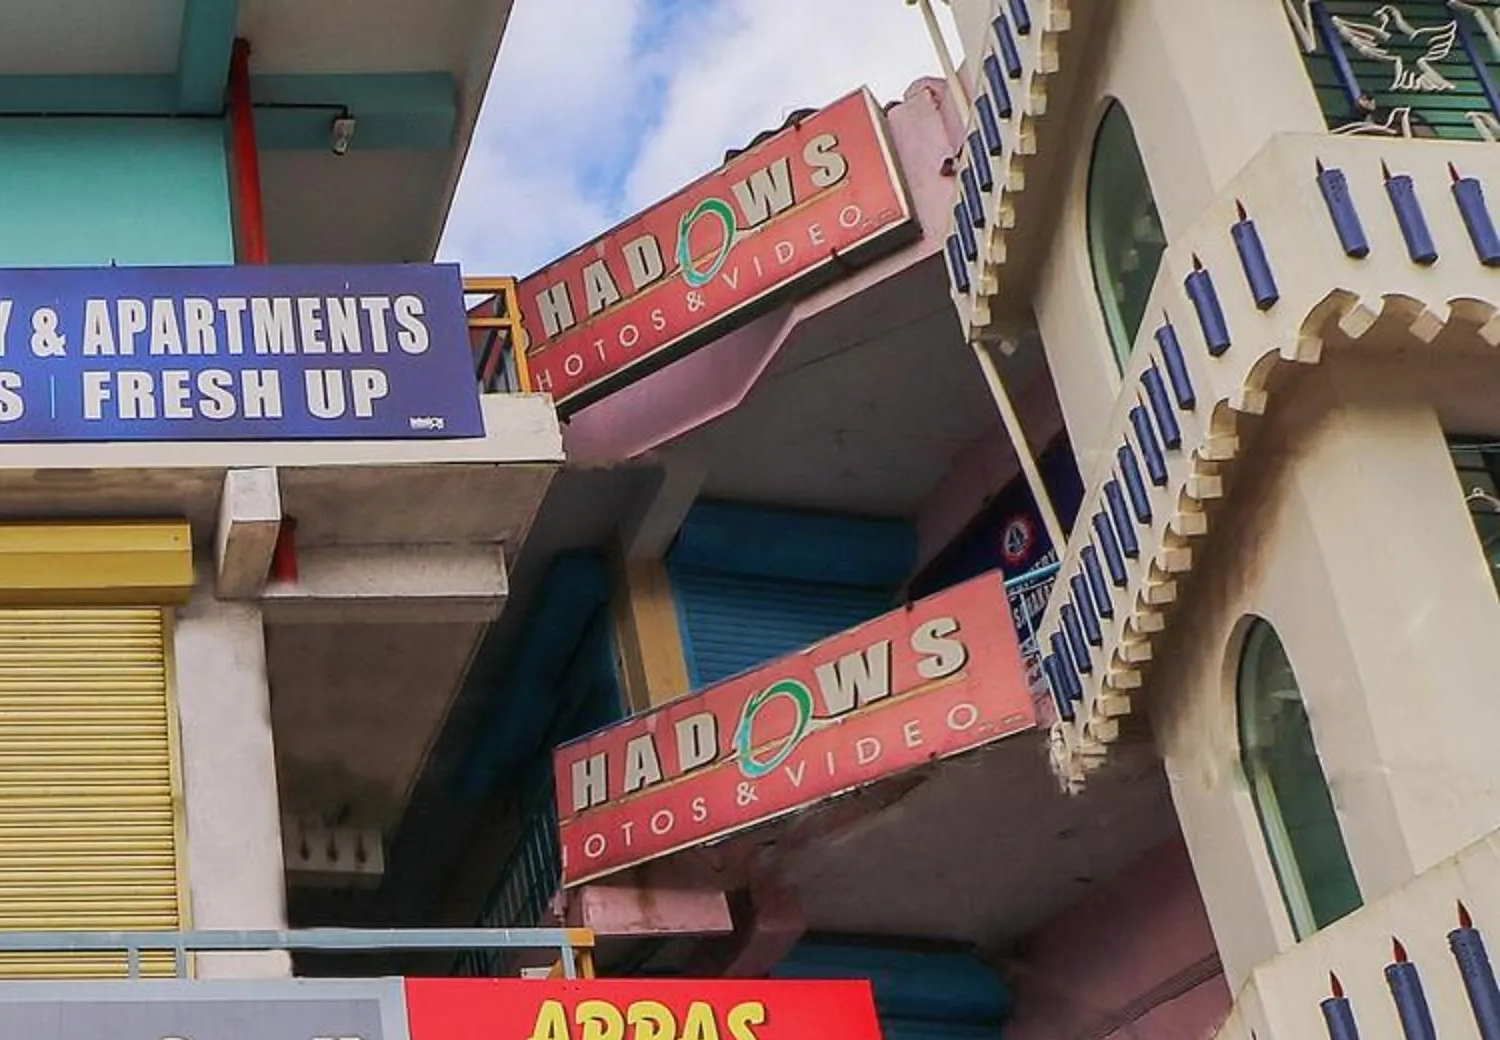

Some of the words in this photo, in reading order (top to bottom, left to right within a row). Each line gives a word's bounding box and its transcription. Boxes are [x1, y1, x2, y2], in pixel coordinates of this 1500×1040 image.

[519, 133, 848, 350] HADOWS
[686, 291, 706, 312] &
[721, 205, 862, 291] VIDEO
[30, 305, 67, 357] &
[83, 295, 431, 356] APARTMENTS
[82, 370, 284, 420] FRESH
[305, 369, 389, 418] UP
[736, 783, 760, 807] &
[785, 703, 979, 787] VIDEO
